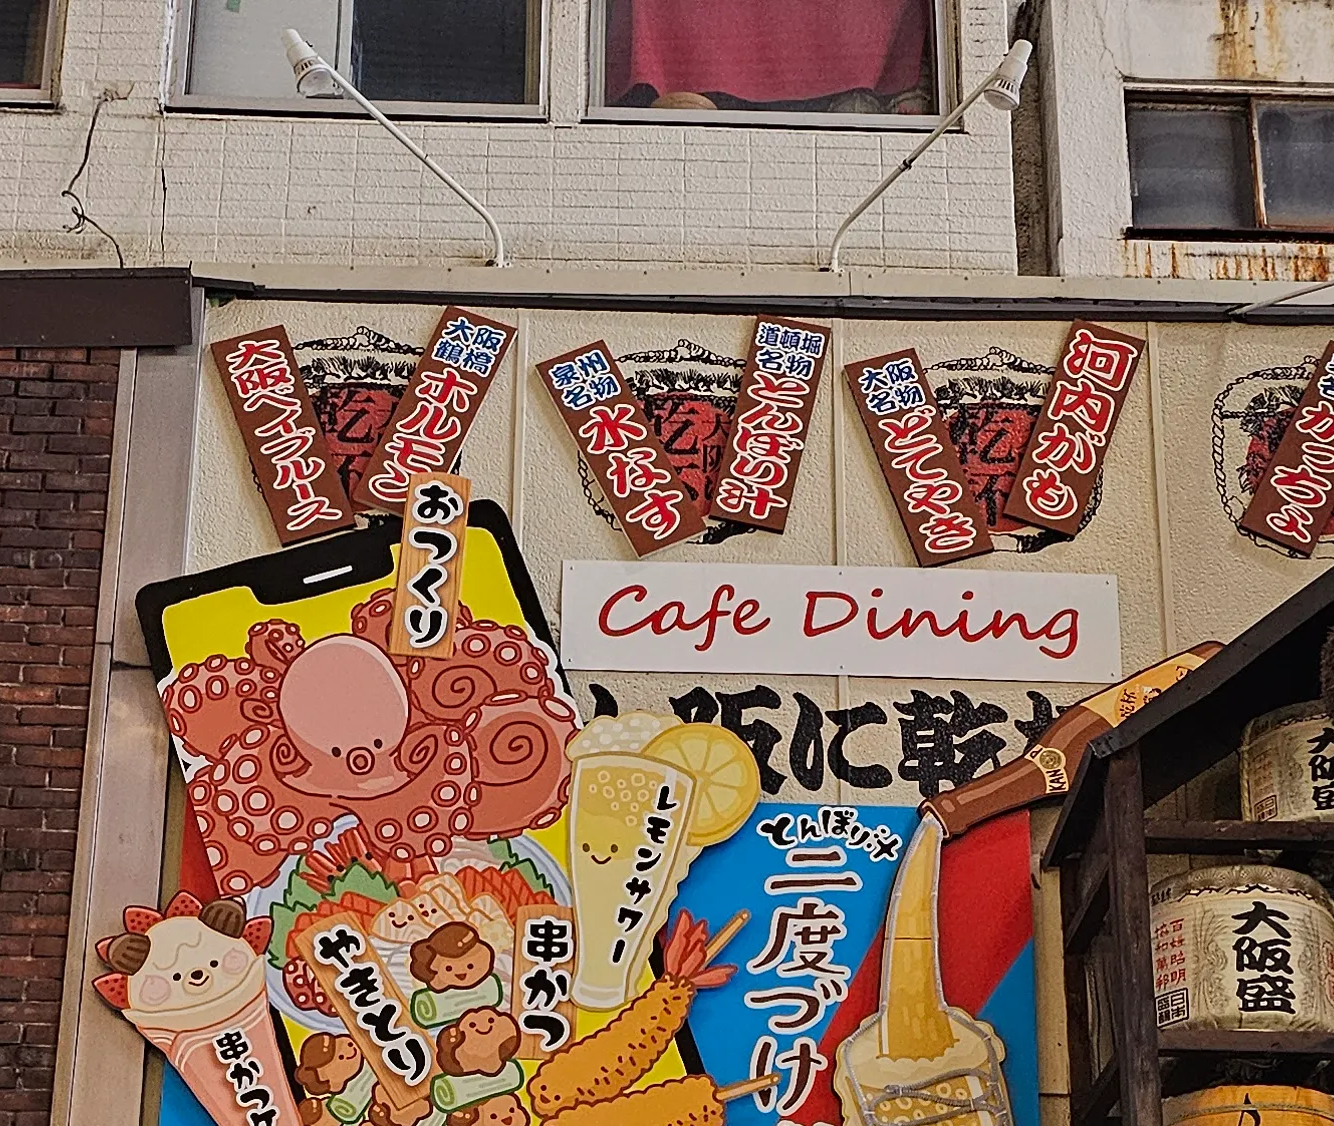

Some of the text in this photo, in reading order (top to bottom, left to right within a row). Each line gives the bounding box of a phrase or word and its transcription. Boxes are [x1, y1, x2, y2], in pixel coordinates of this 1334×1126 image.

[432, 339, 494, 376] 鶴橋
[447, 315, 506, 353] 大阪
[550, 349, 611, 388] 泉州
[756, 349, 814, 380] 名物
[757, 322, 825, 356] 道頓堀
[859, 357, 918, 393] 大阪
[227, 340, 342, 531] 大阪ベイブルース
[369, 366, 478, 502] ホルモン
[562, 373, 622, 411] 名物
[868, 384, 925, 415] 名物
[1023, 329, 1138, 521] 河内がも
[579, 403, 684, 540] 水なす
[878, 405, 977, 553] どてやき
[408, 483, 462, 645] おつくり
[597, 583, 1080, 661] Cafe Dining
[581, 682, 1072, 797] 阪に乾
[609, 784, 677, 966] レモンサワー
[313, 924, 432, 1086] やきとり
[521, 916, 573, 1050] 串かつ
[1231, 900, 1297, 1015] 大阪盛
